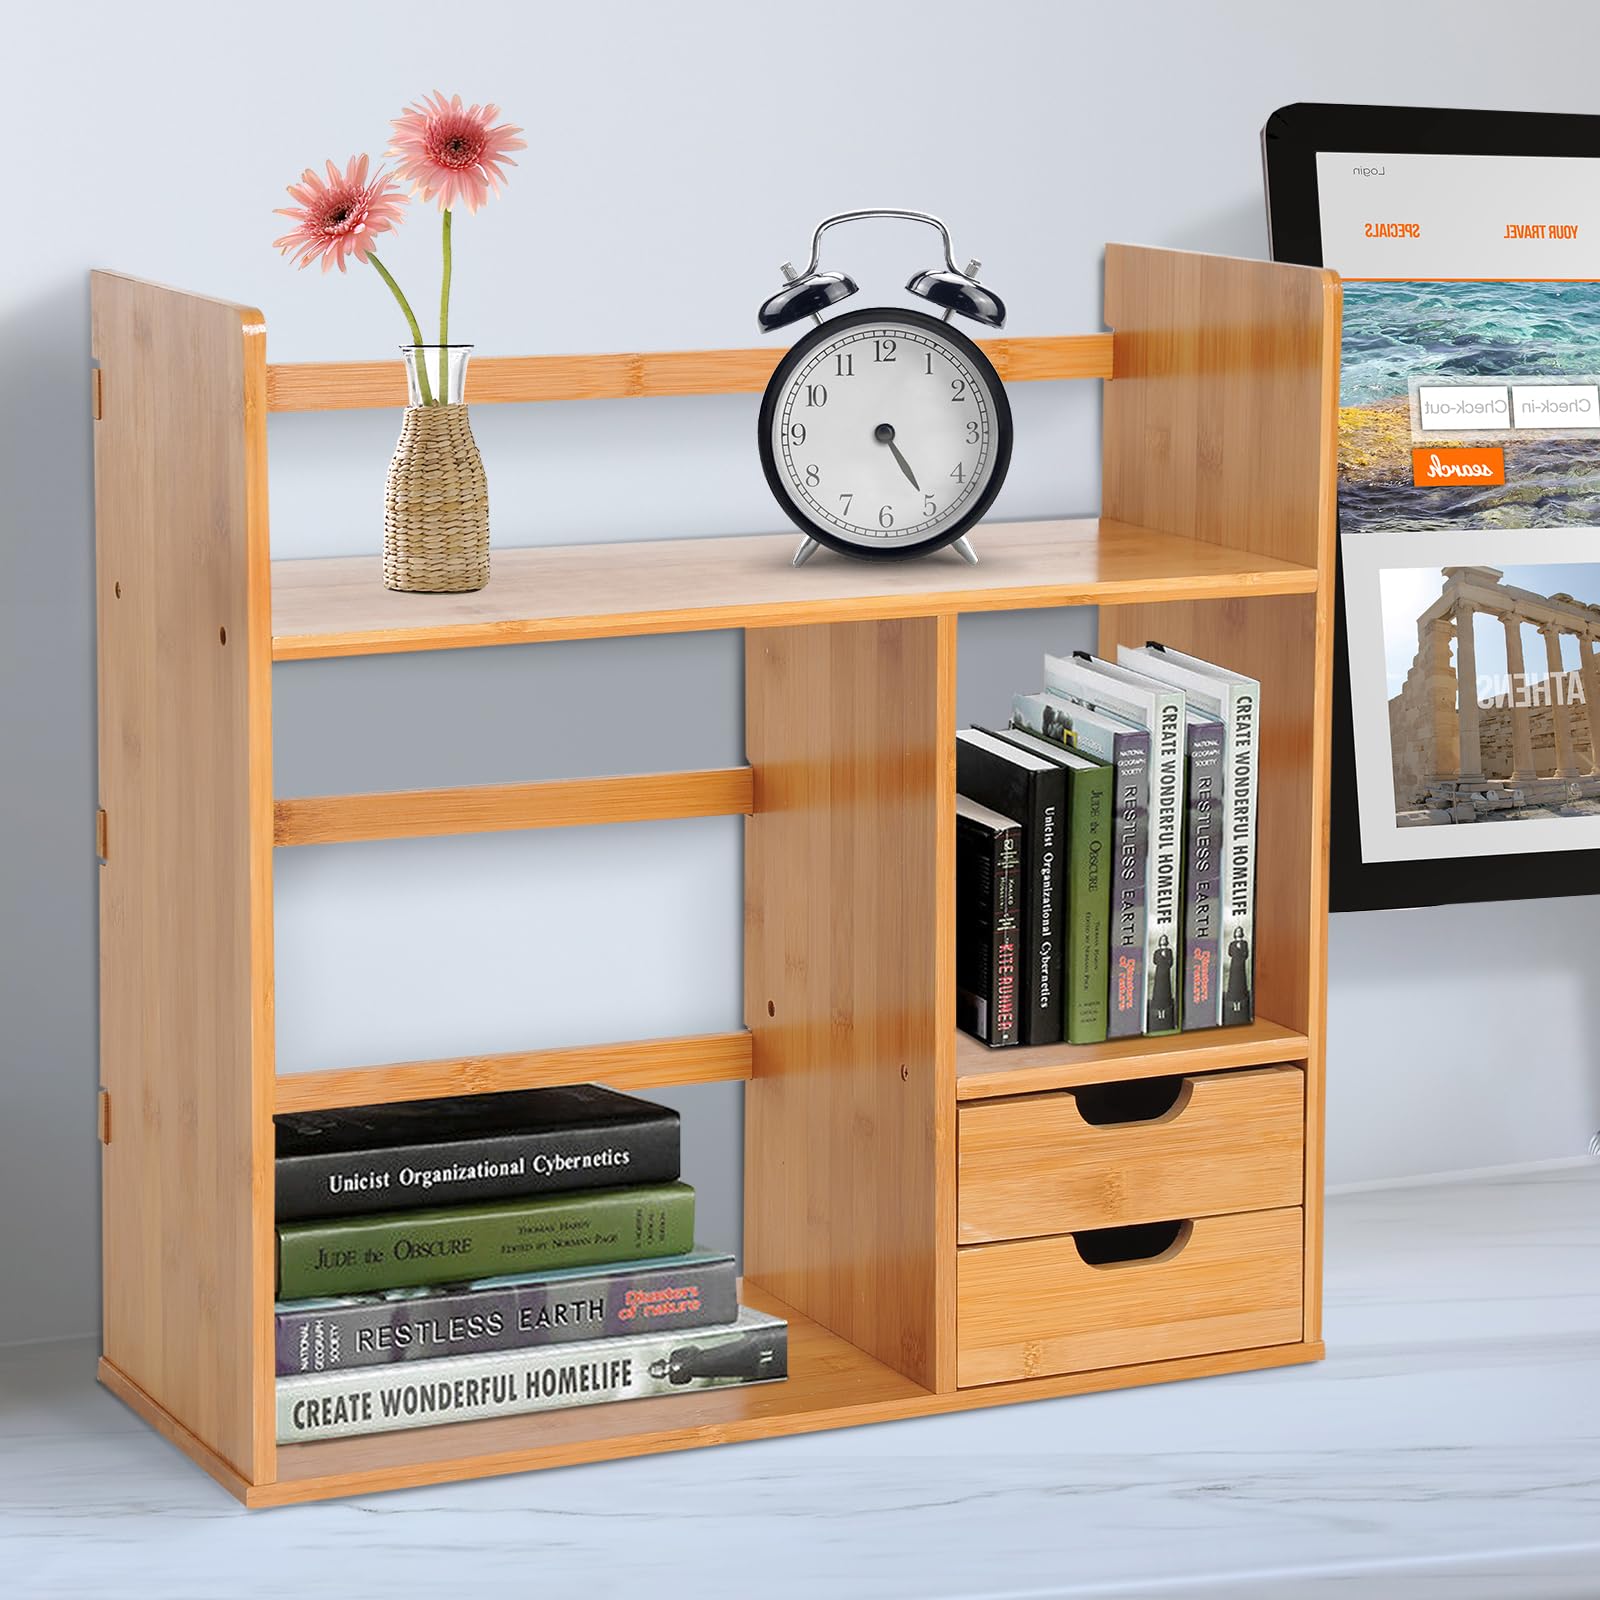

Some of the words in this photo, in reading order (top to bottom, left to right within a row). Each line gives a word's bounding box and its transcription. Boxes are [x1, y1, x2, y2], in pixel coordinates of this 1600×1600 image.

[835, 354, 855, 377] 11
[873, 340, 897, 362] 12
[925, 352, 933, 375] 1
[806, 384, 827, 407] 10
[951, 379, 965, 402] 2
[791, 423, 806, 446] 9
[966, 421, 979, 444] 3
[806, 464, 820, 487] 8
[950, 462, 966, 484] 4
[839, 494, 853, 516] 7
[879, 505, 894, 528] 6
[923, 494, 937, 517] 5
[1162, 705, 1179, 756] CREATE
[1235, 695, 1253, 748] CREATE
[1119, 749, 1145, 757] NATIONAL
[1193, 740, 1219, 748] NATIONAL
[1120, 767, 1144, 776] SOCIETY
[1194, 758, 1217, 767] SOCIETY
[1090, 789, 1103, 818] JUDE
[1158, 761, 1177, 850] WONDERFUL
[1233, 752, 1251, 841] WONDERFUL
[1044, 806, 1055, 848] Unicist
[1121, 785, 1138, 880] RESTLESS
[1195, 775, 1212, 871] RESTLESS
[1089, 840, 1103, 892] OBSCURE
[1231, 844, 1249, 916] HOMELIFE
[1040, 852, 1054, 937] Organizational
[1156, 853, 1175, 925] HOMELIFE
[1119, 888, 1135, 946] EARTH
[1195, 880, 1210, 938] EARTH
[998, 943, 1015, 975] KITE
[1039, 941, 1052, 1009] Cybernetics
[1125, 958, 1136, 1009] Disasters
[1200, 951, 1211, 1002] Disasters
[997, 977, 1013, 1031] RUNNER
[328, 1171, 390, 1194] Unicist
[399, 1157, 525, 1188] Organizational
[533, 1149, 631, 1176] Cybernetics
[517, 1223, 556, 1235] THOMAS
[559, 1219, 592, 1231] HARDY
[314, 1248, 355, 1270] JUDE
[364, 1248, 384, 1264] the
[393, 1238, 472, 1261] OBSCURE
[500, 1243, 531, 1254] EDITED
[552, 1237, 592, 1250] NORMAN
[594, 1233, 621, 1245] PAGE
[617, 1306, 637, 1321] of
[643, 1300, 701, 1318] nature
[624, 1286, 700, 1306] Disasters
[356, 1311, 503, 1353] RESTLESS
[518, 1298, 604, 1331] EARTH
[299, 1323, 309, 1371] NATIONAL
[329, 1323, 341, 1363] SOCIETY
[293, 1391, 372, 1431] CREATE
[380, 1373, 517, 1418] WONDERFUL
[526, 1359, 633, 1400] HOMELIFE
